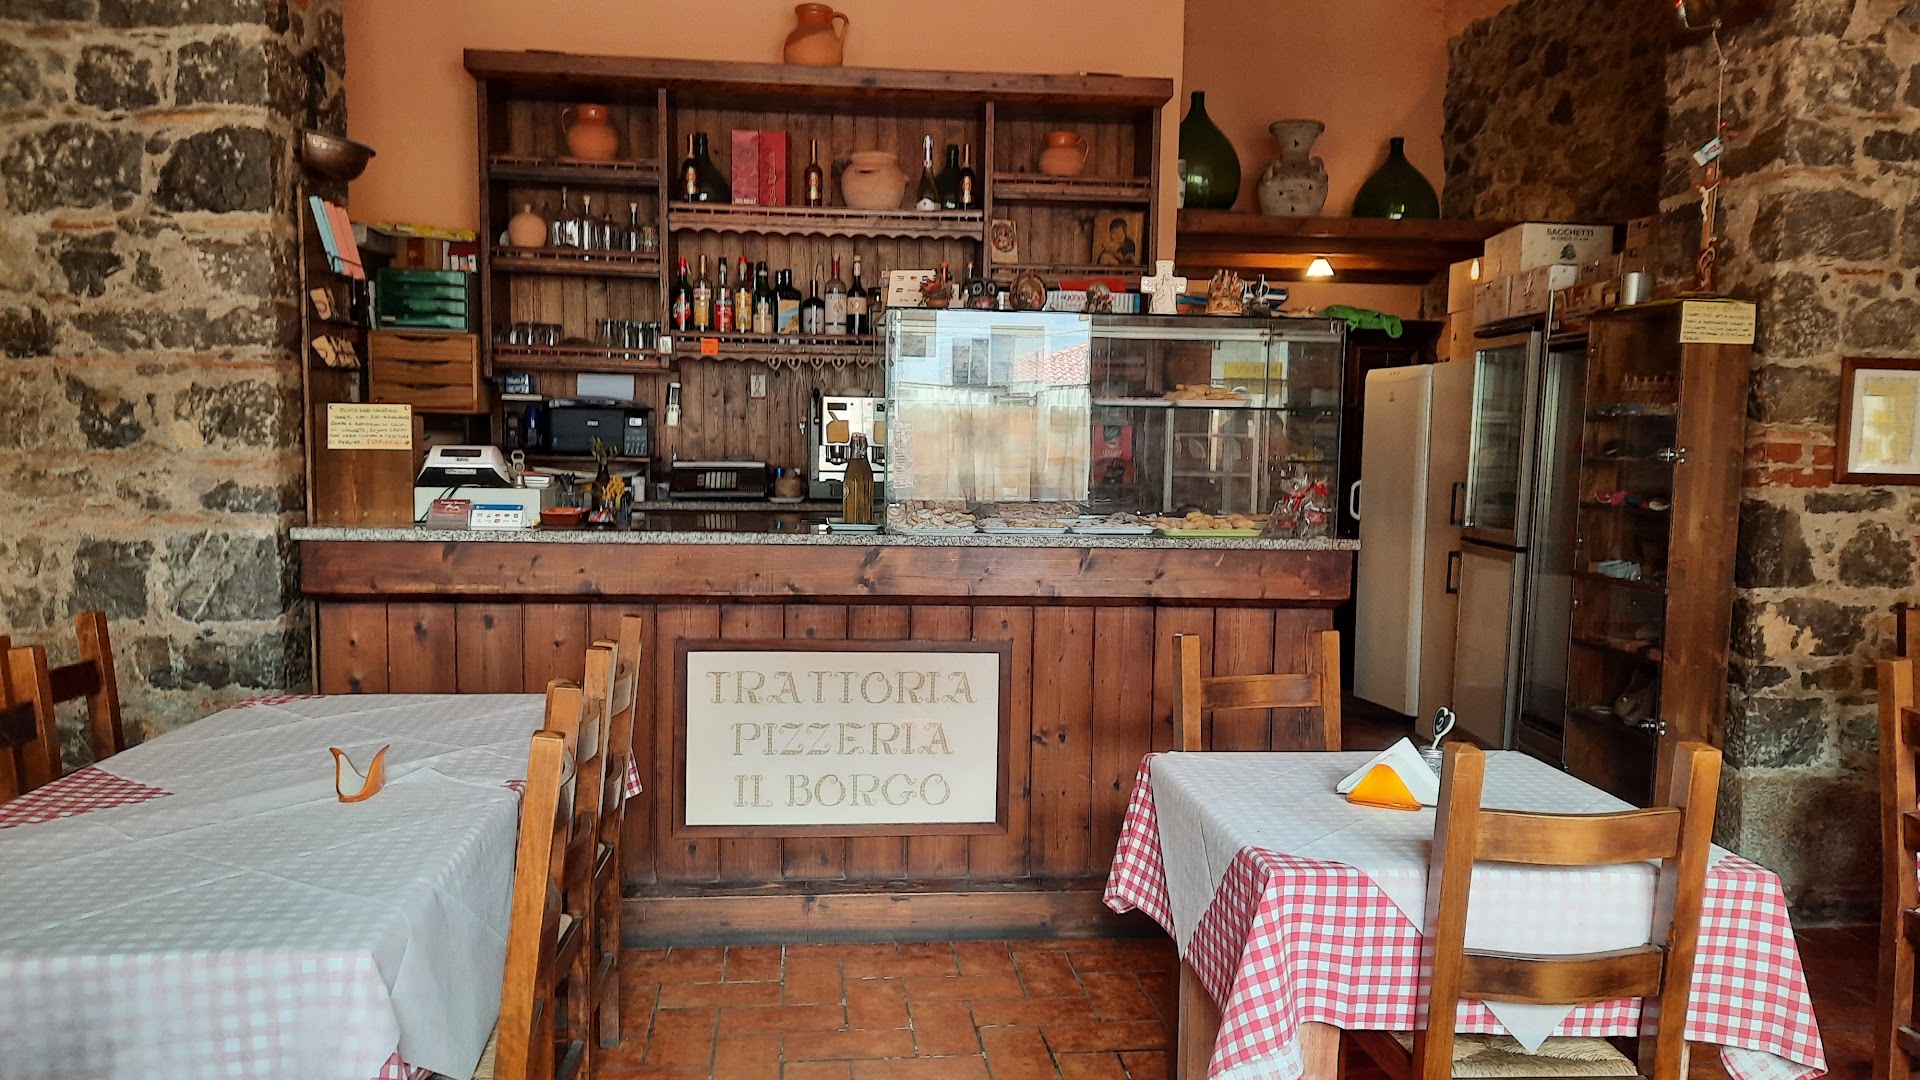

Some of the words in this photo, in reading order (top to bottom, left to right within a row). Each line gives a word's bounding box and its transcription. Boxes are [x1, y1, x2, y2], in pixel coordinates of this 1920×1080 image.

[1546, 228, 1594, 237] SACCHETTI
[705, 670, 978, 704] TRATTORIA
[730, 722, 955, 756] PIZZERIA
[1436, 717, 1444, 732] 2
[733, 774, 774, 808] IL
[784, 773, 951, 807] BORGO
